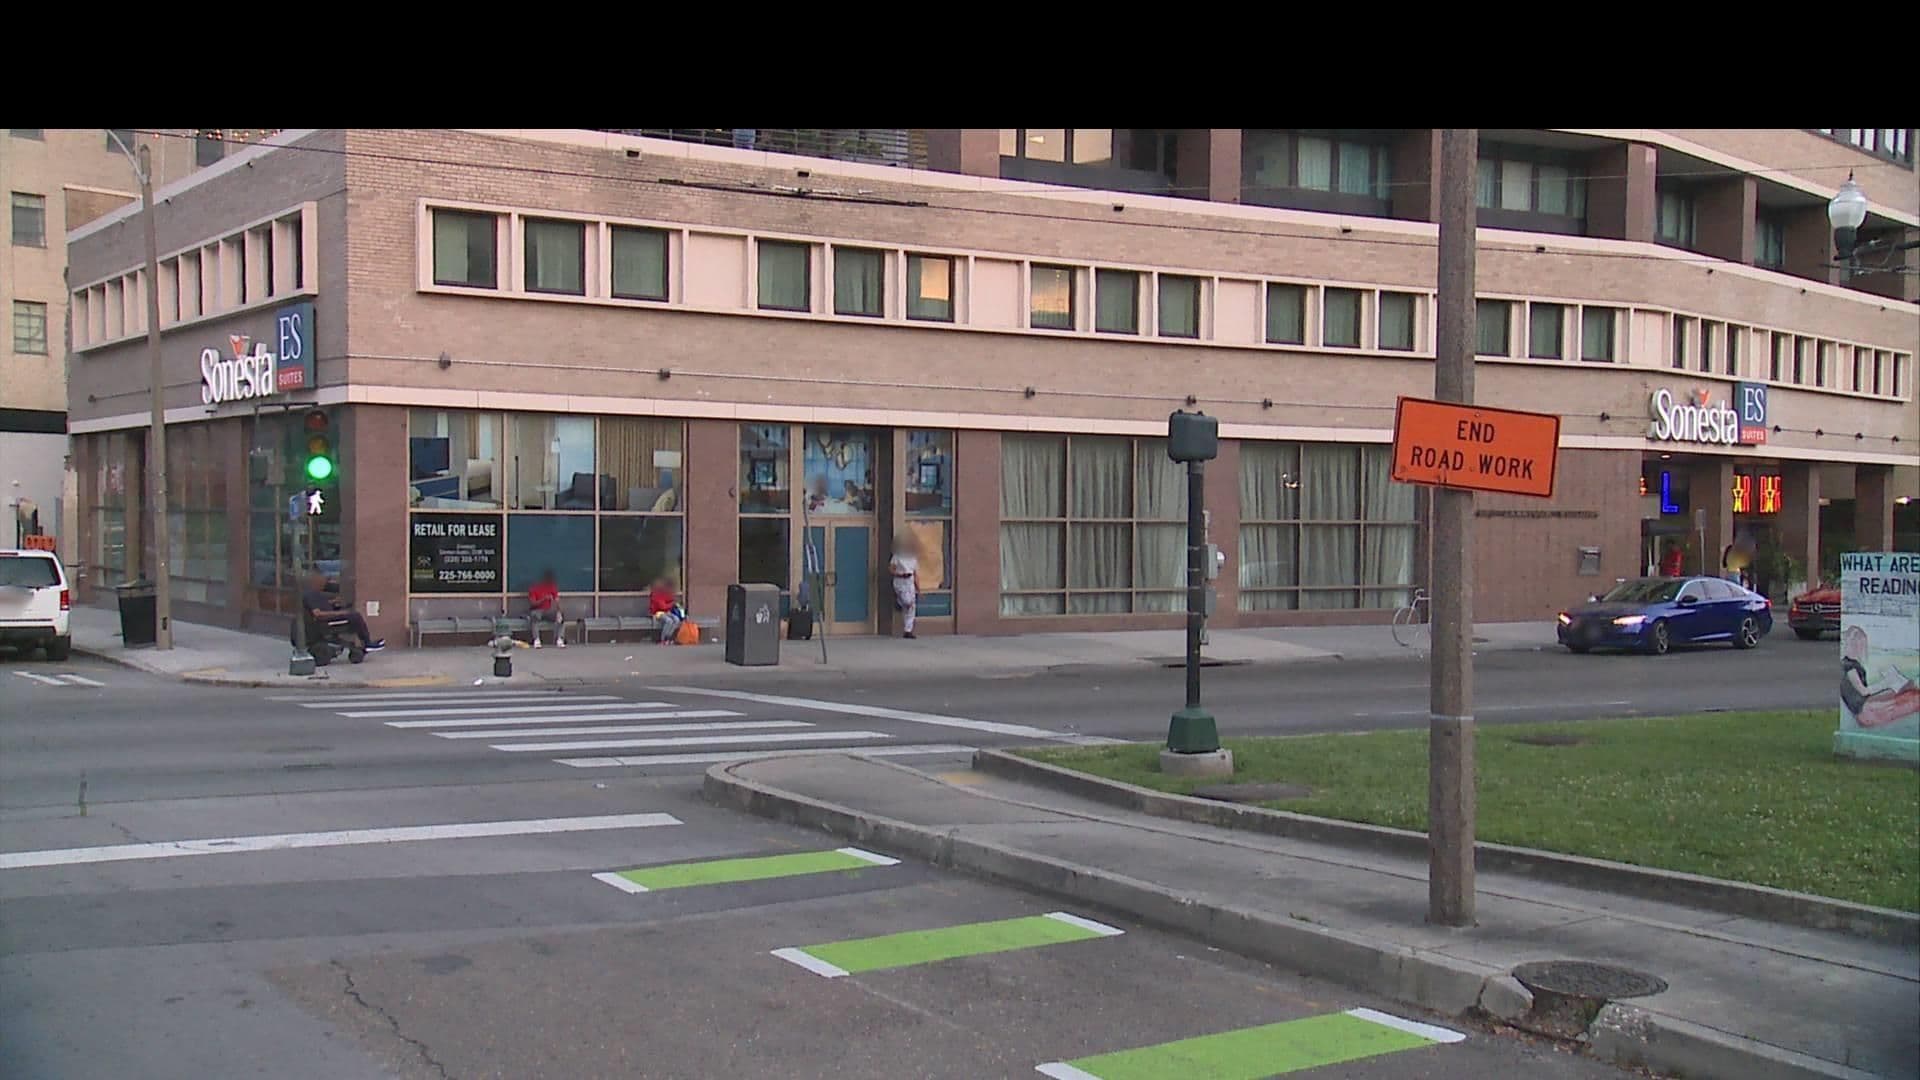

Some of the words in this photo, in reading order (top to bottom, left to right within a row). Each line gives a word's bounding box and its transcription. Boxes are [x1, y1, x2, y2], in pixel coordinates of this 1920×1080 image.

[280, 313, 302, 361] ES
[201, 343, 273, 404] Sonesta
[279, 371, 303, 385] SUITES
[1656, 388, 1738, 443] Sonesta
[1744, 387, 1764, 422] ES
[1457, 420, 1495, 443] END
[1742, 429, 1764, 440] SUITES
[1410, 446, 1464, 471] ROAD
[1479, 453, 1534, 480] WORK
[414, 523, 446, 537] RETAIL
[448, 524, 466, 537] FOR
[467, 524, 496, 537] LEASE
[1842, 555, 1883, 572] WHAT
[1890, 556, 1920, 573] ARE
[1860, 576, 1920, 595] READIN
